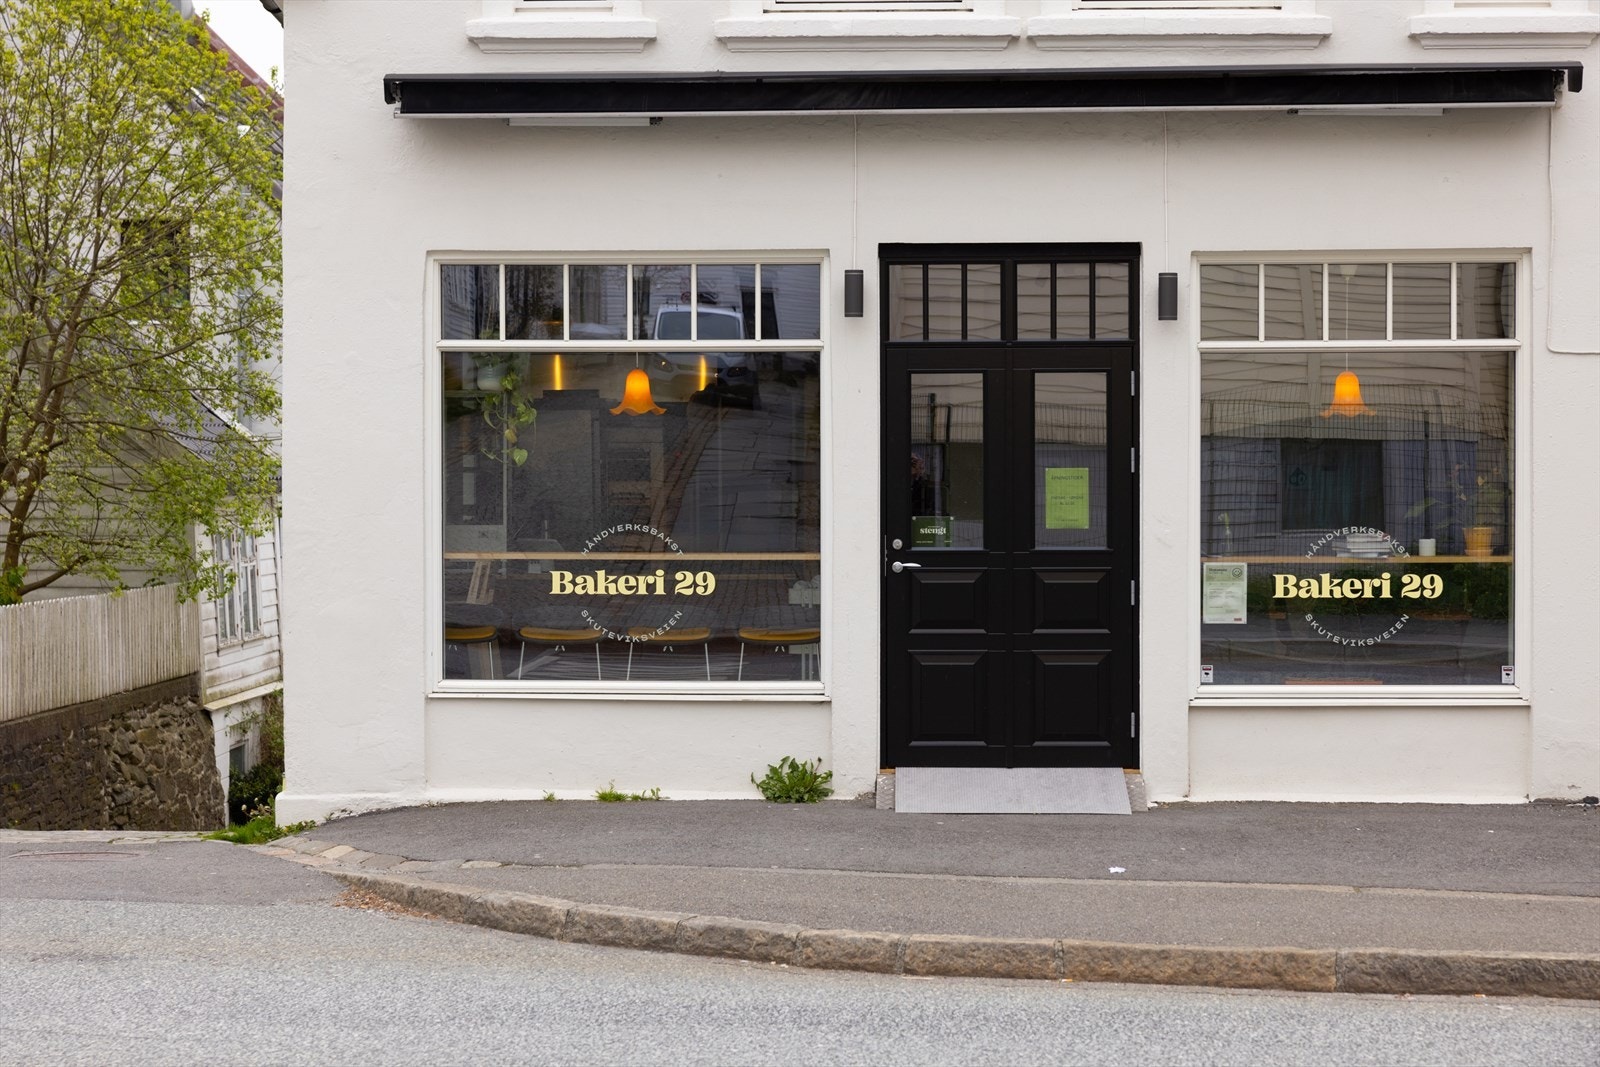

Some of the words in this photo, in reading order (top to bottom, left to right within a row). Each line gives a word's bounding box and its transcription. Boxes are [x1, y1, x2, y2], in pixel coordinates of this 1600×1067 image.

[581, 523, 684, 557] HÅNDVERKSBAKST
[919, 526, 947, 536] stengt
[1305, 526, 1411, 560] HÅNDVERKSBAKST
[549, 569, 667, 595] Bakeri
[674, 571, 716, 596] 29
[1272, 572, 1393, 599] Bakeri
[1401, 573, 1444, 599] 29
[581, 609, 683, 643] SKUTEVIKSVEIEN
[1305, 613, 1410, 647] SKUTEVIKSVEIEN
